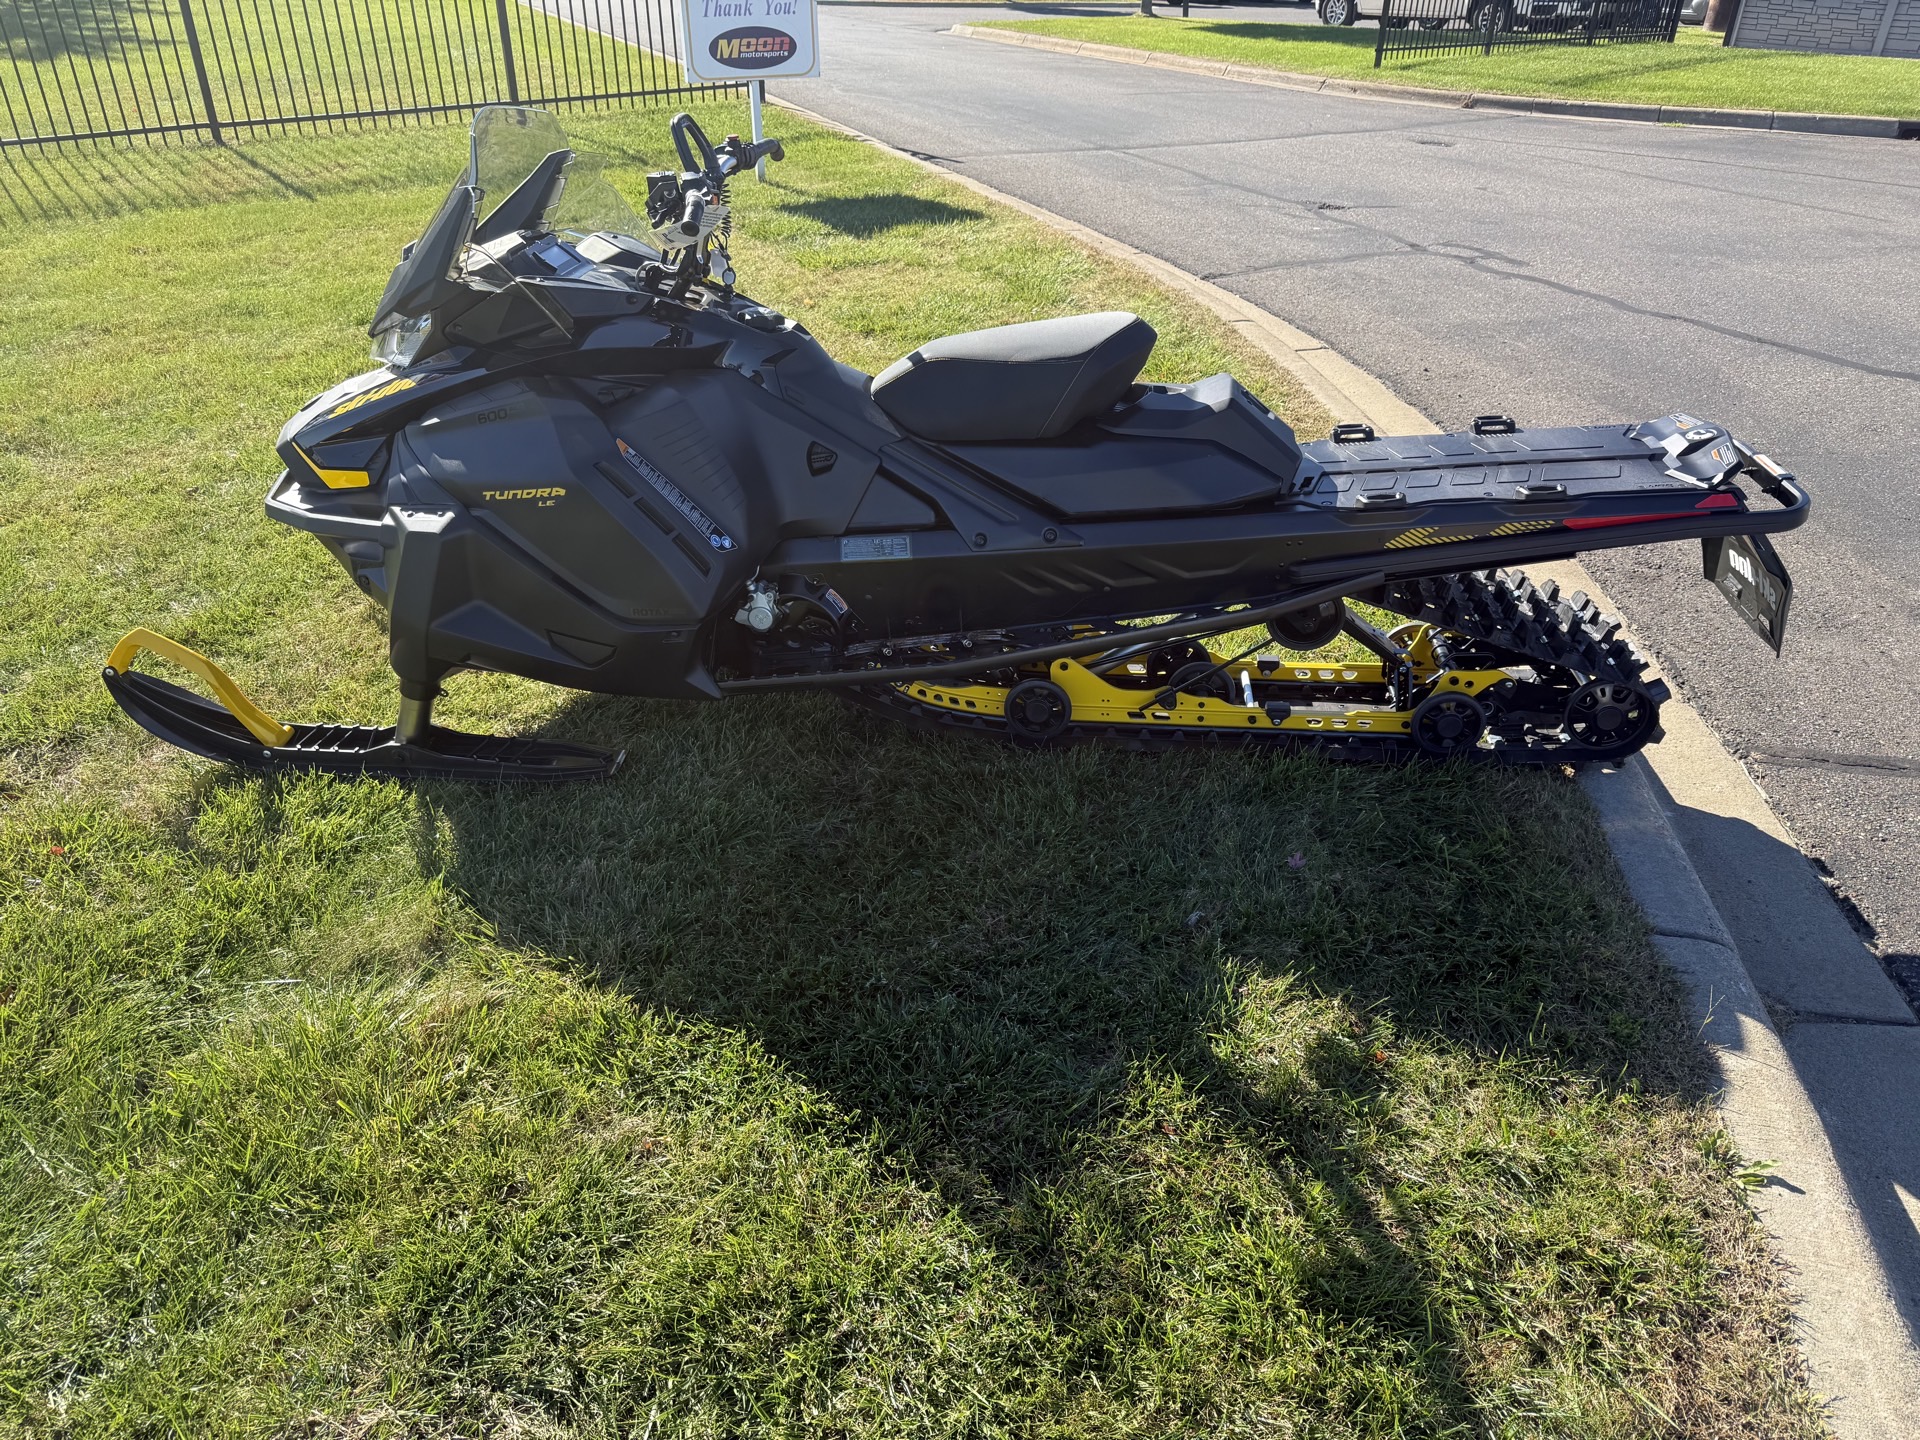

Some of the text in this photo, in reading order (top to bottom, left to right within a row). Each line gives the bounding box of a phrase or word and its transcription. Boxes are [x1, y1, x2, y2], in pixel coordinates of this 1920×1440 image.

[701, 0, 798, 17] Thank You!
[478, 408, 508, 425] 600
[482, 487, 567, 501] TUNDRA
